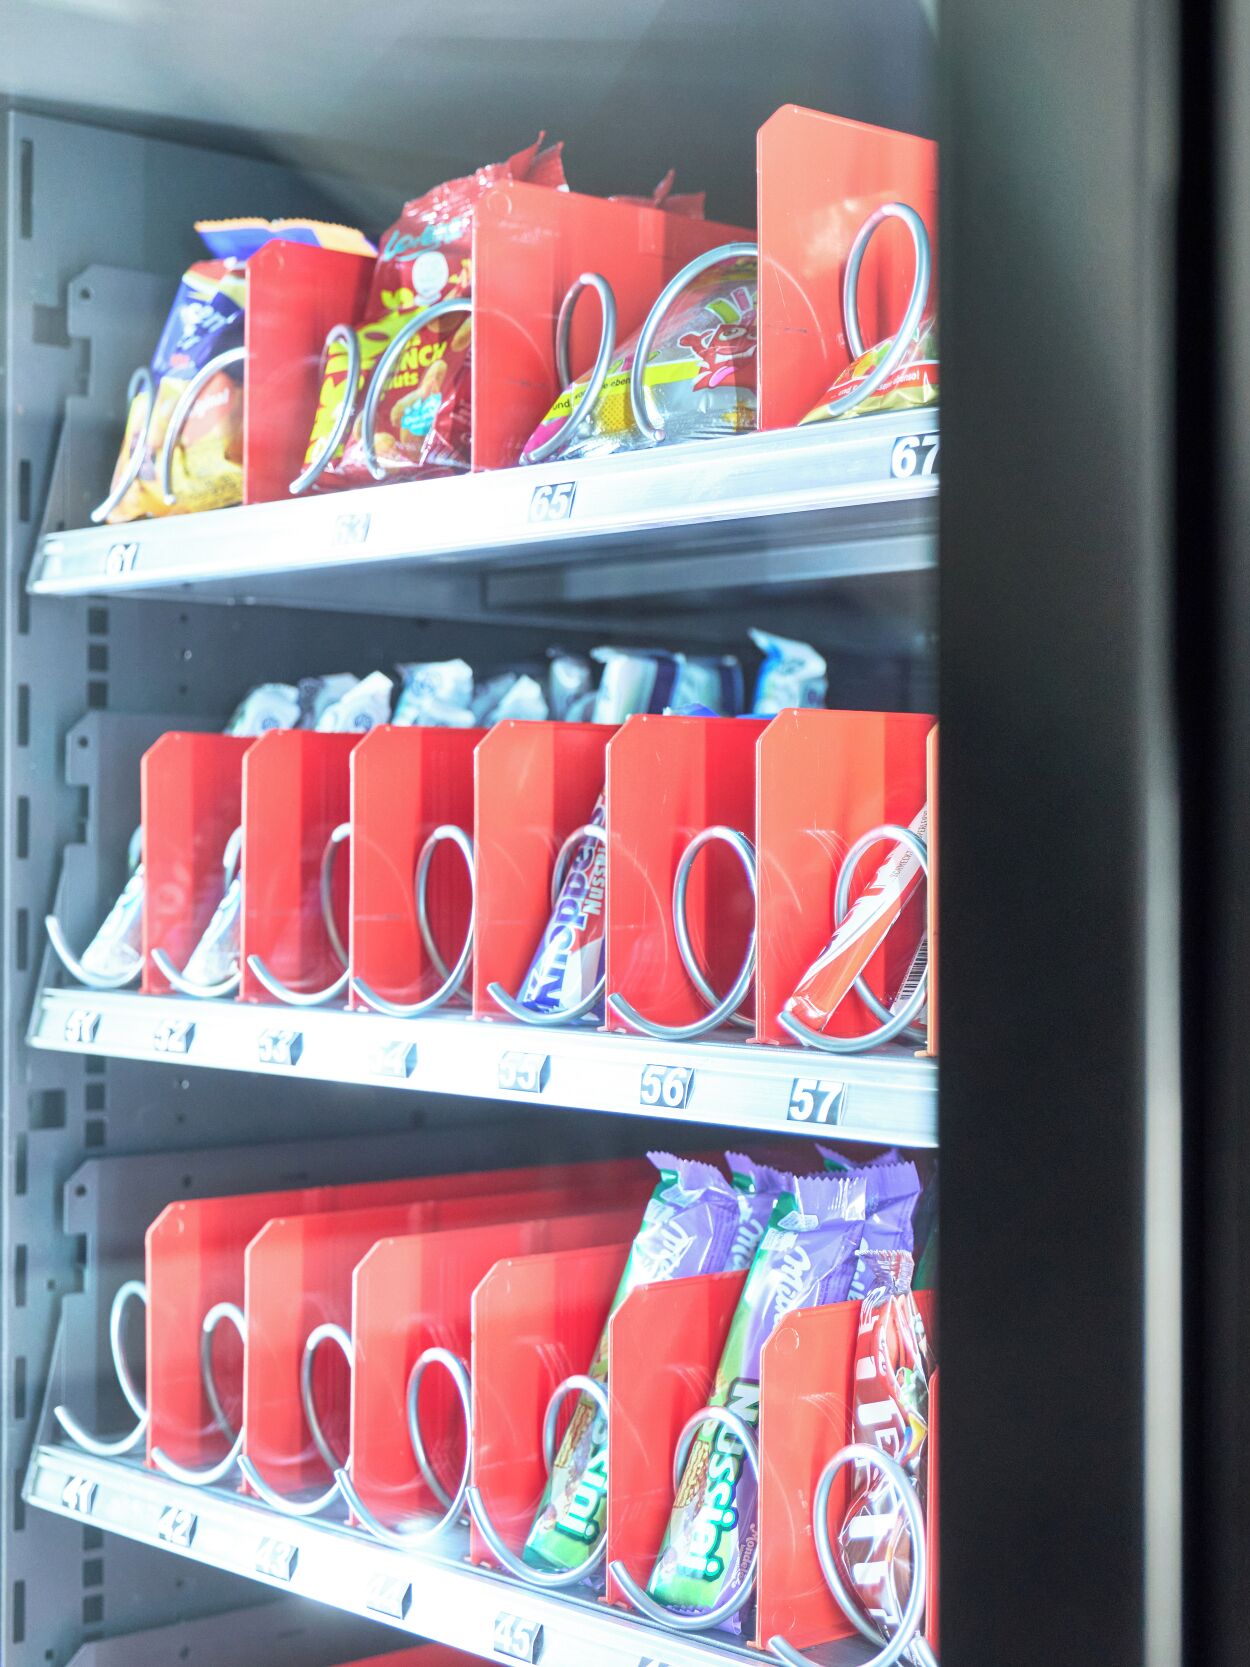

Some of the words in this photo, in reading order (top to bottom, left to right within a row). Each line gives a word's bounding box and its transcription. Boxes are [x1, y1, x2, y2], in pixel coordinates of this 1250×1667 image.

[891, 435, 939, 479] 67
[529, 484, 571, 521] 65
[105, 543, 138, 575] 61
[499, 1054, 538, 1089] 55
[641, 1065, 686, 1107] 56
[790, 1079, 841, 1122] 57
[159, 1505, 193, 1544] 42
[494, 1613, 535, 1658] 45
